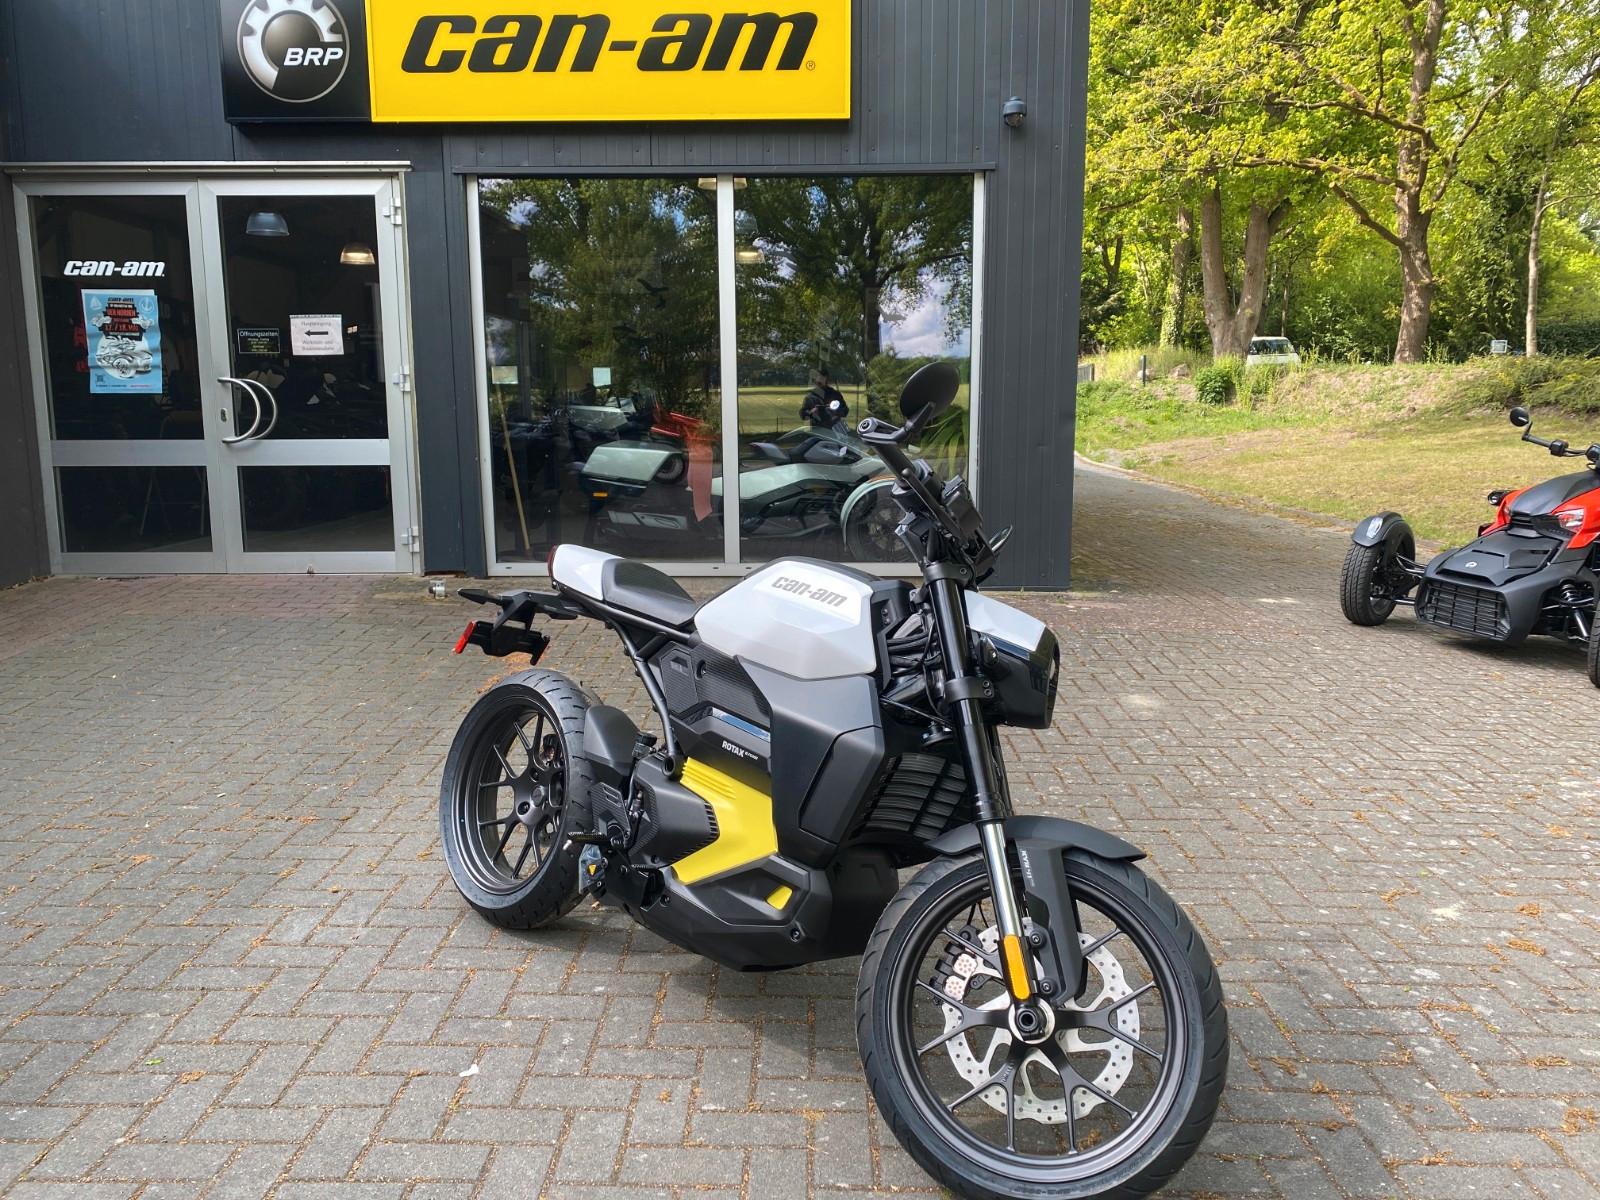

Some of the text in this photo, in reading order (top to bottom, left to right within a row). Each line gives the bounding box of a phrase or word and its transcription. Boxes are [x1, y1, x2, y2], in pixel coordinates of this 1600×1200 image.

[400, 11, 819, 73] can-am
[283, 47, 344, 66] BRP
[63, 260, 166, 277] can-am
[771, 576, 848, 607] can-am
[721, 740, 745, 758] ROTAX
